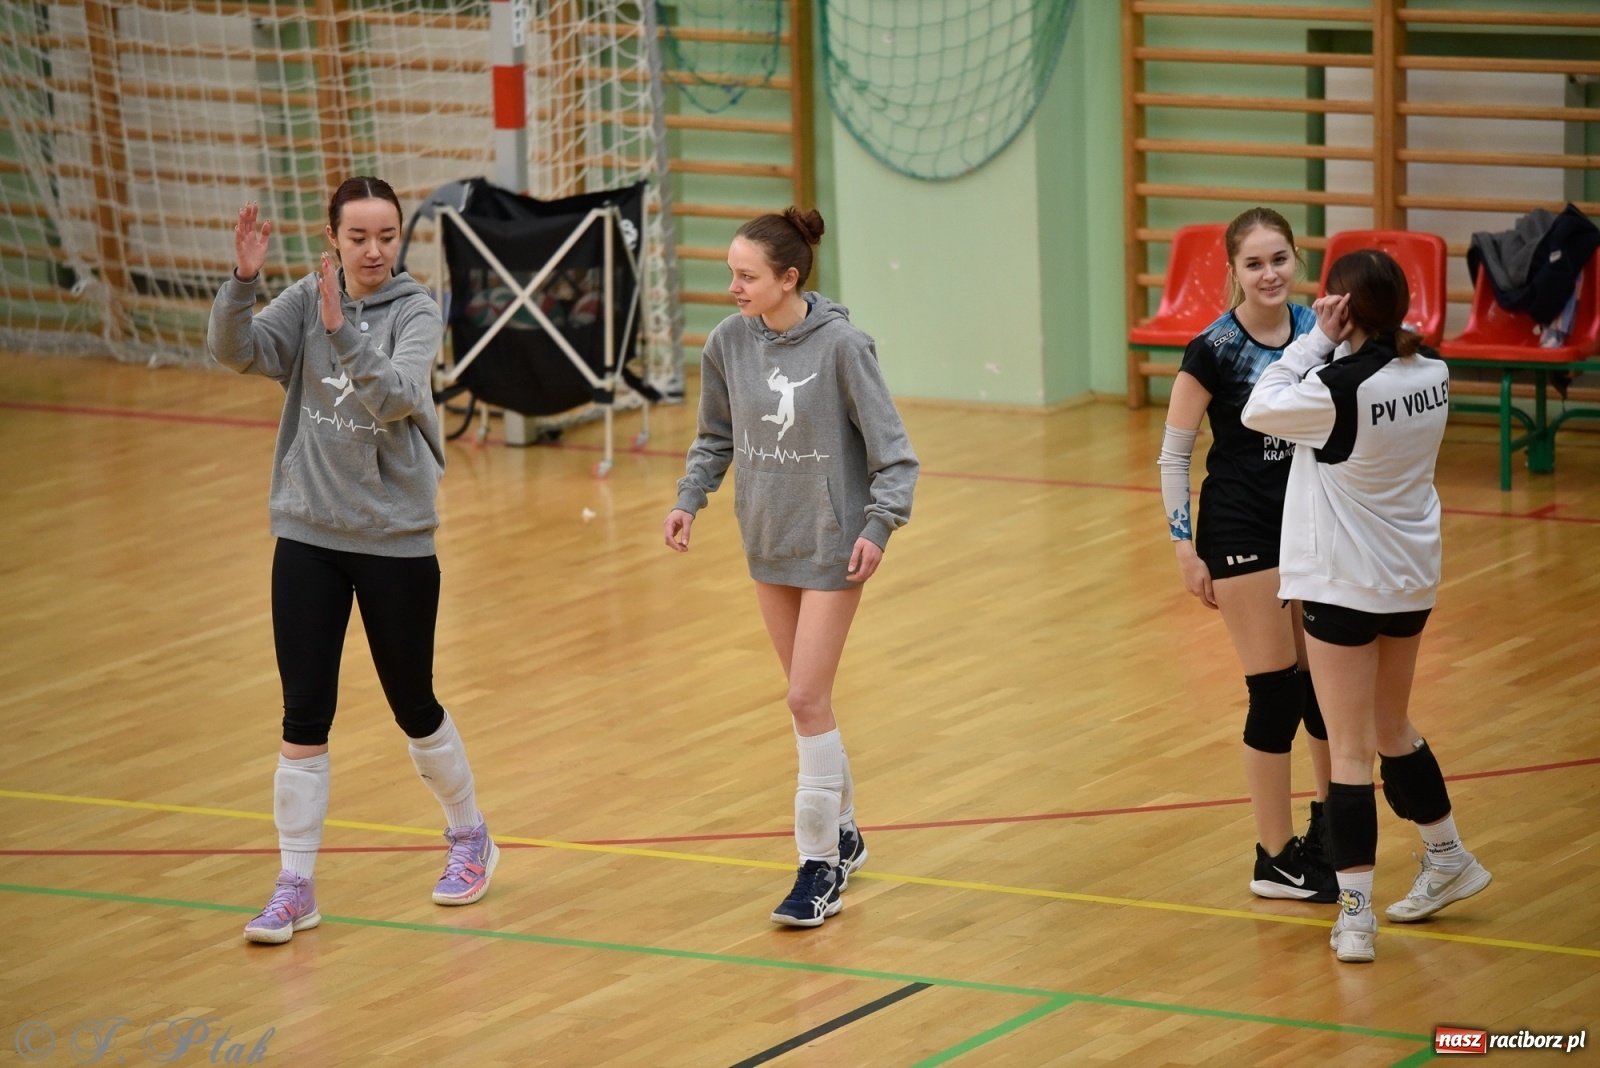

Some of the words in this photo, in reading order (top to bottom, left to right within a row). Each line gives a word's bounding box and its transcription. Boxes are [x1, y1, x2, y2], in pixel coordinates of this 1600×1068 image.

[1371, 399, 1397, 426] PV
[1402, 377, 1449, 417] VOLLE
[1263, 435, 1281, 450] PV
